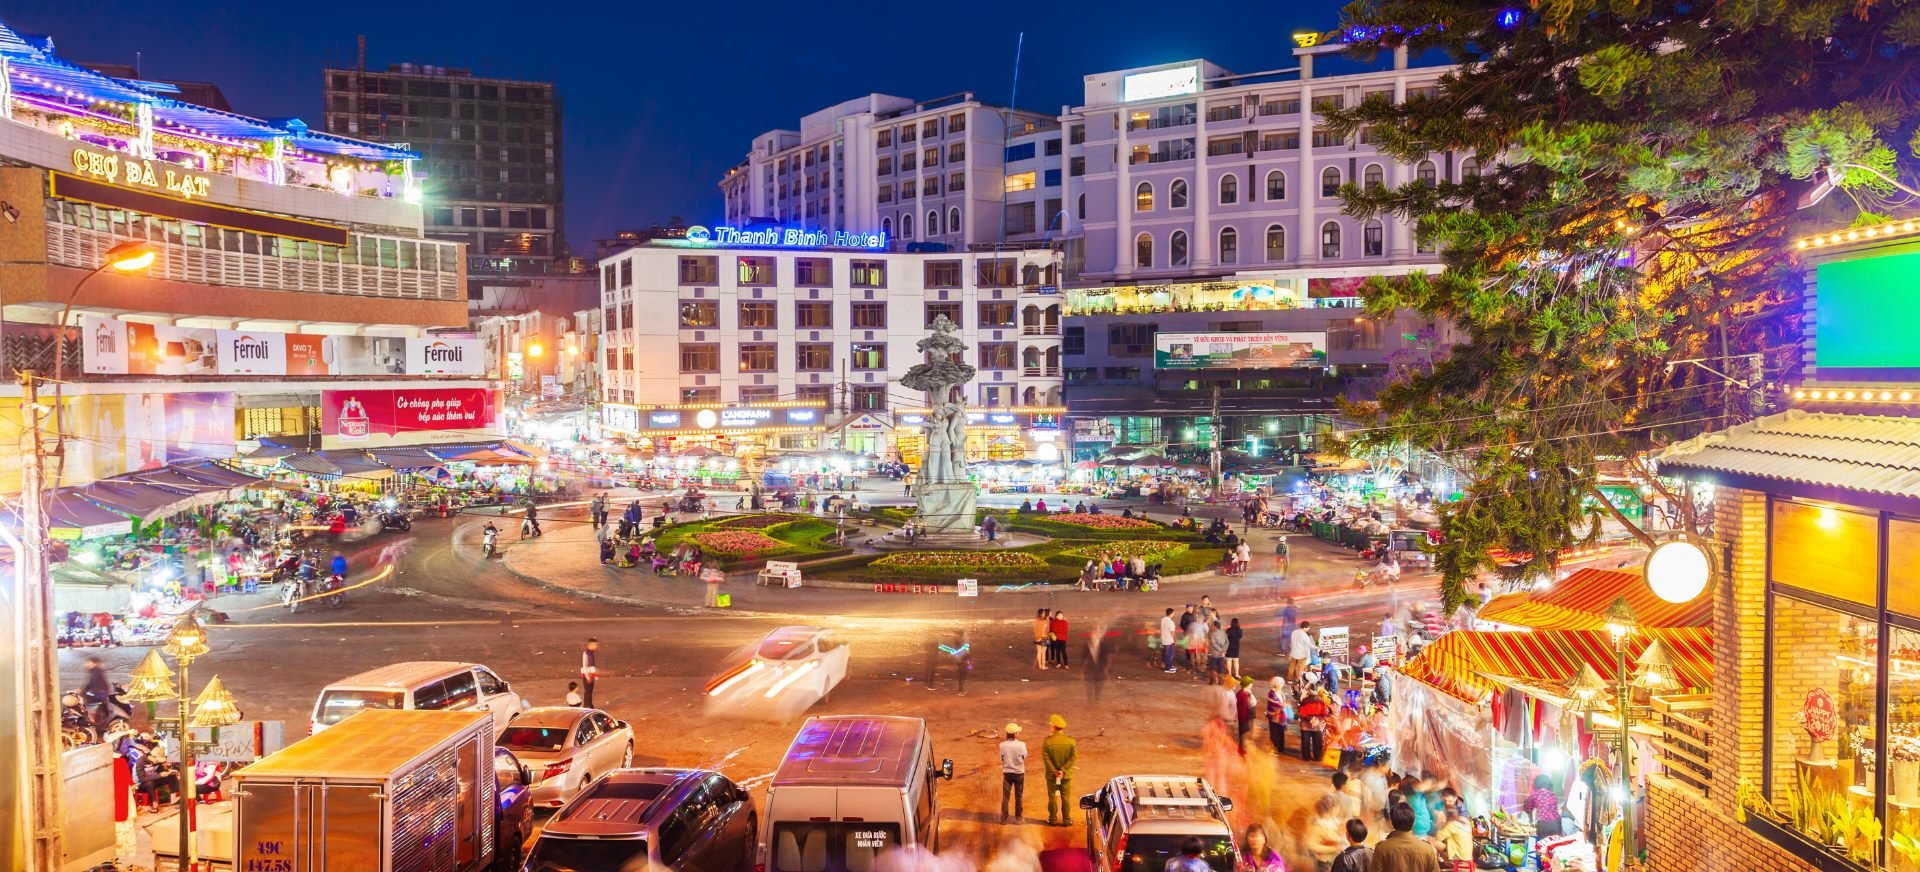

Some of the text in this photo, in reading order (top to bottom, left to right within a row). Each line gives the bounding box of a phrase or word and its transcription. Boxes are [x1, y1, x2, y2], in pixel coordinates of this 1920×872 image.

[73, 149, 210, 198] CHỢ ĐÀ LẠT
[715, 227, 778, 244] Thanh
[833, 231, 885, 247] Hotel
[97, 328, 116, 357] Ferroli
[234, 340, 268, 362] Ferroli
[425, 345, 463, 364] Ferroli
[431, 398, 444, 409] phụ
[446, 398, 461, 410] giúp
[446, 410, 463, 420] thêm
[341, 420, 367, 429] Neptune
[350, 427, 366, 435] Gold
[257, 841, 284, 855] 49C
[858, 839, 883, 847] NHÂN VIÊN
[248, 859, 291, 872] 147.58
